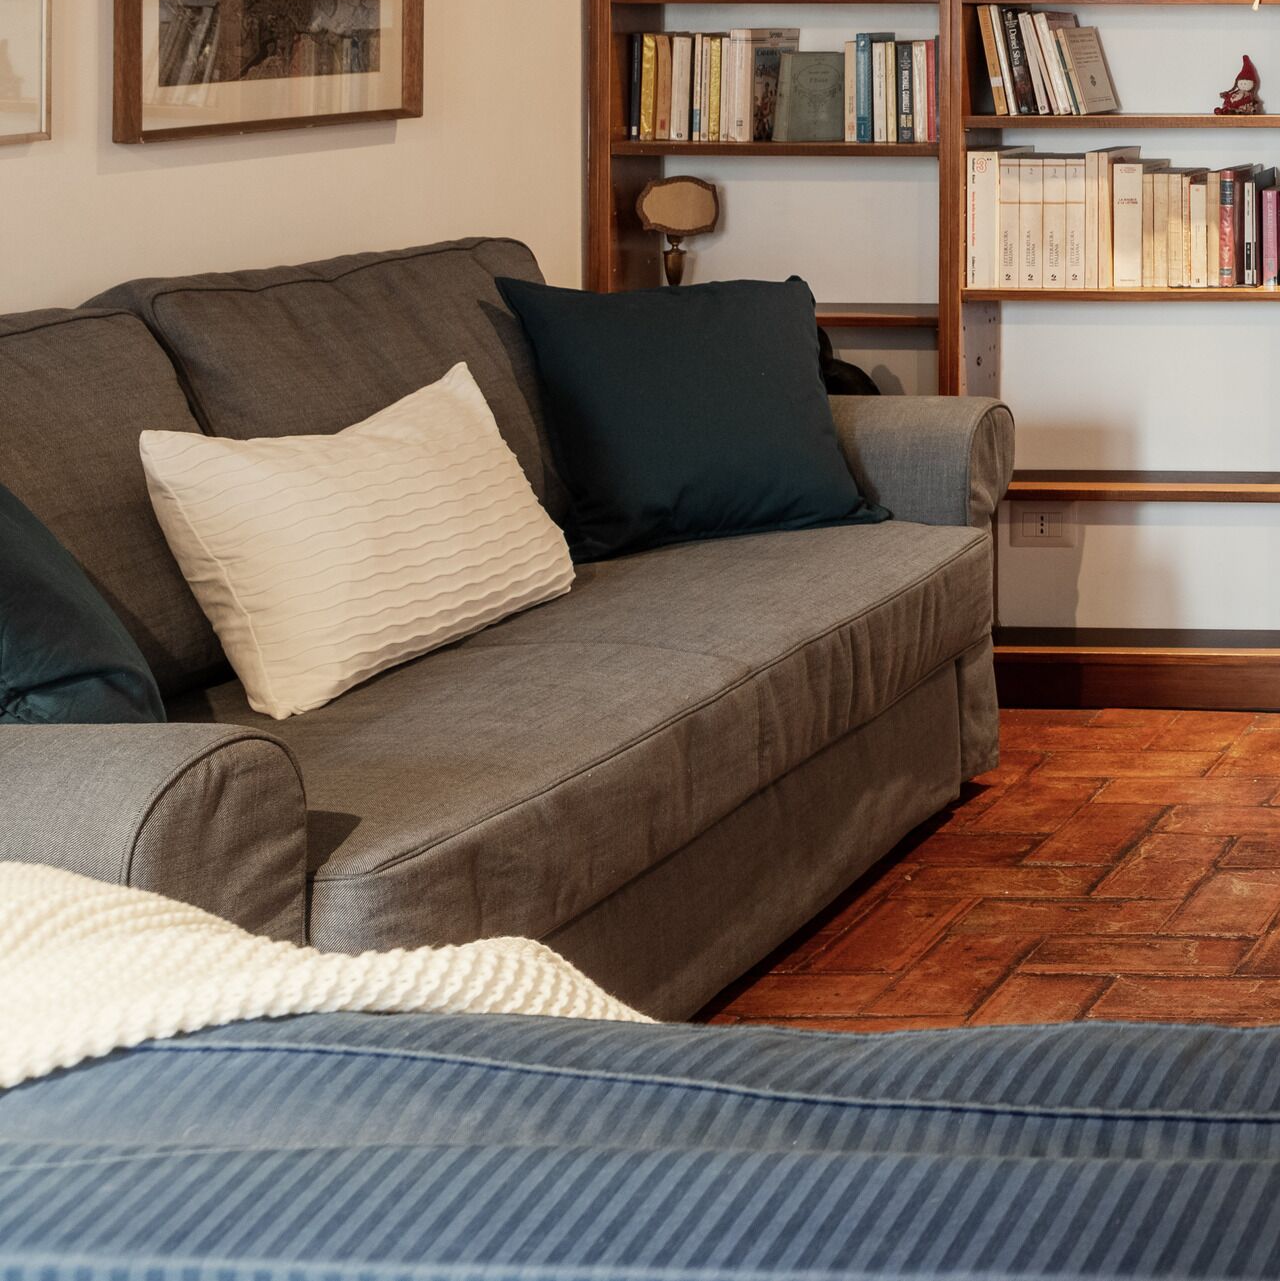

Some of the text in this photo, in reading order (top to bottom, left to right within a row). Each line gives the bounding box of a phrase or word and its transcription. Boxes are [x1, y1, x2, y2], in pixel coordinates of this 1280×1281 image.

[1008, 28, 1021, 66] Daniel Silva
[902, 70, 911, 113] MICHAEL CONNELLY
